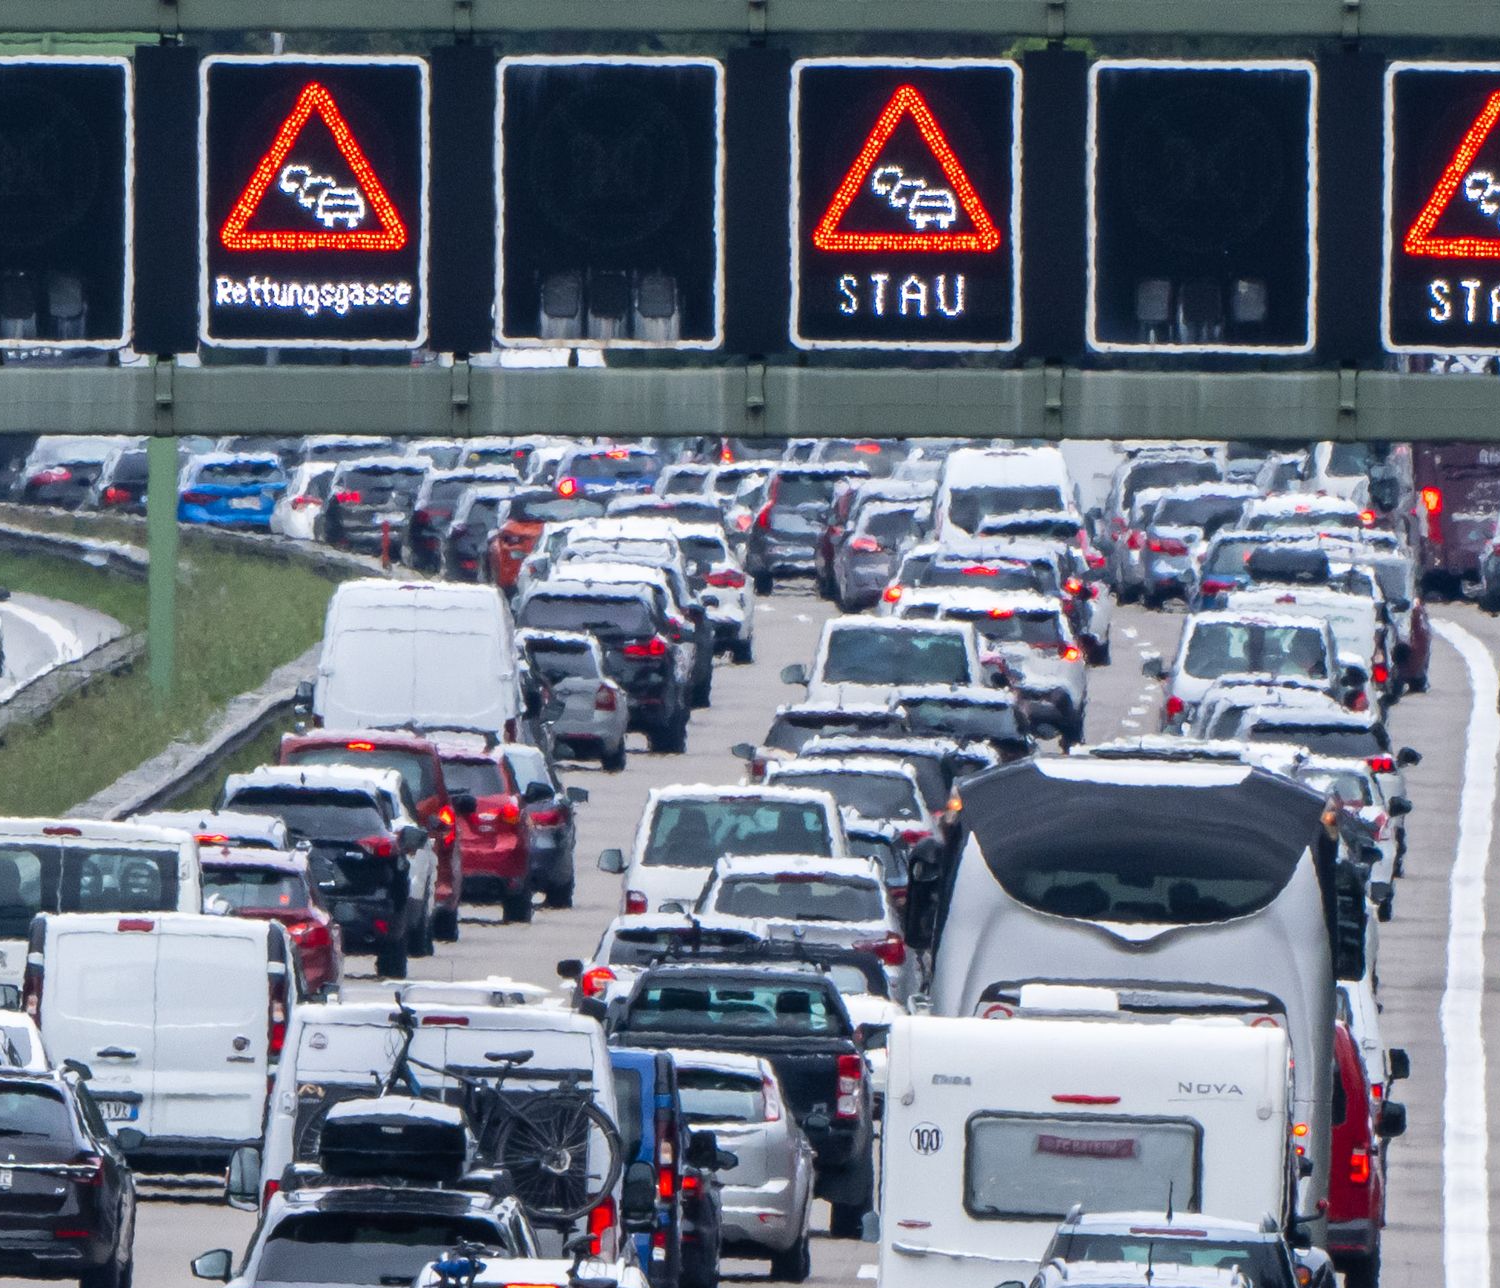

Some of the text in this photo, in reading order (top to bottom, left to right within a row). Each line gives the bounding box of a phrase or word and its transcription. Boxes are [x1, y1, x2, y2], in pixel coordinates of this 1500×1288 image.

[215, 275, 412, 315] Rettungsgasse
[839, 273, 966, 317] STAU
[913, 1128, 942, 1152] 100
